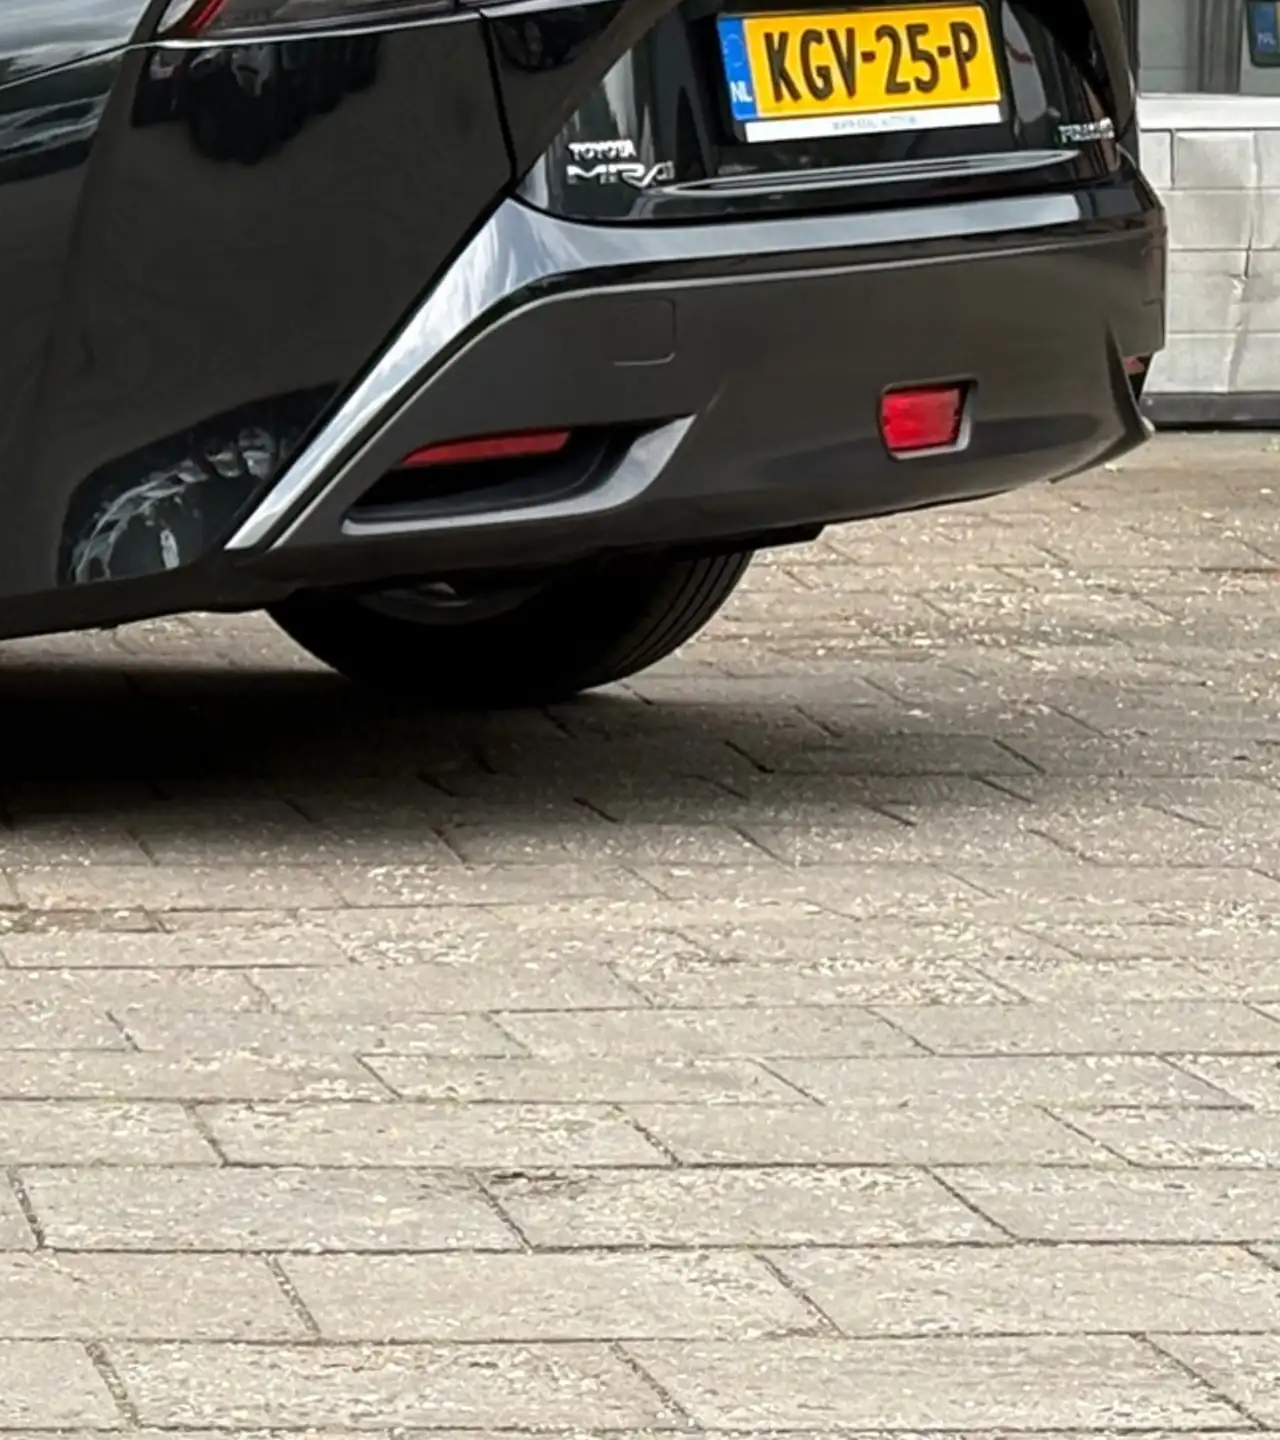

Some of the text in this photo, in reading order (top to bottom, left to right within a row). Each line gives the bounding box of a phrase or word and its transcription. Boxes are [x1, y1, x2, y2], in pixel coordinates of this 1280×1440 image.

[763, 20, 979, 104] KGV-25-P
[729, 79, 754, 102] NL
[568, 139, 638, 162] TOYOTA
